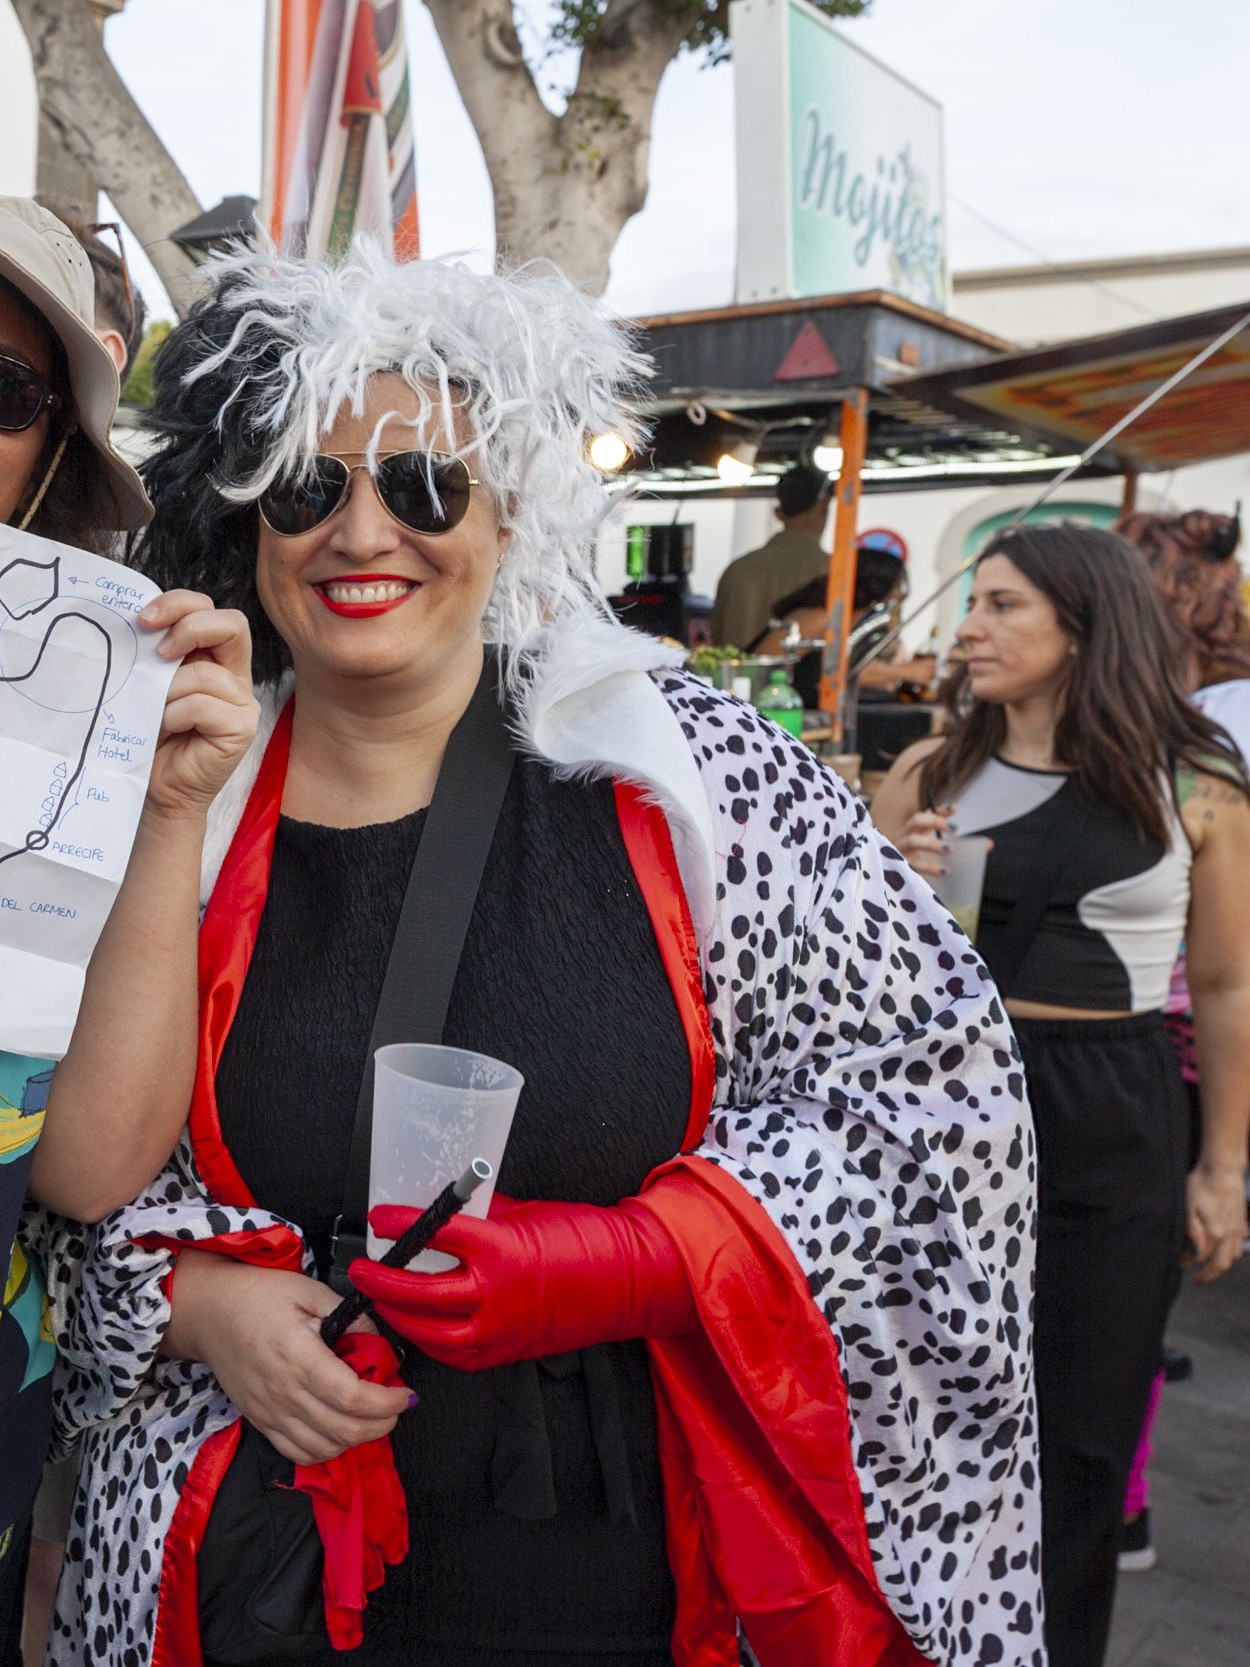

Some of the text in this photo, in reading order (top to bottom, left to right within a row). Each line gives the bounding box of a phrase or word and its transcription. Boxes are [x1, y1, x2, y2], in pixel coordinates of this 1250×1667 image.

[800, 108, 941, 268] Mojitos
[102, 594, 143, 613] entero
[102, 727, 147, 746] Fabricar
[98, 744, 132, 763] Hotel
[87, 787, 109, 802] Pub
[52, 841, 105, 862] ARRECIFE
[0, 897, 22, 911] DEL
[29, 902, 77, 919] CARMEN
